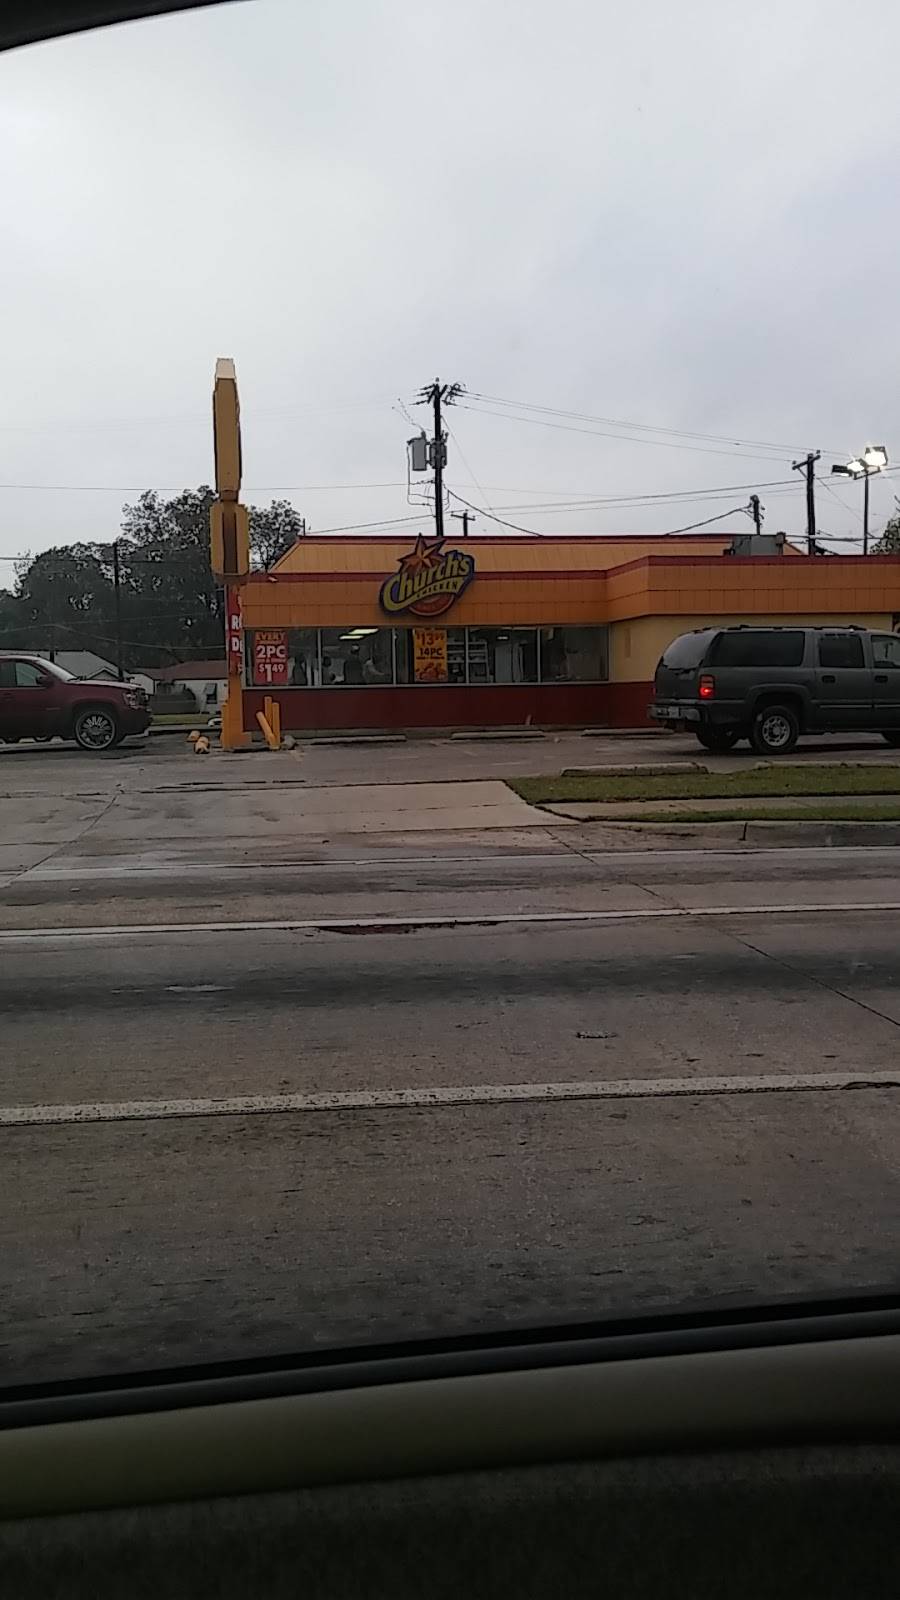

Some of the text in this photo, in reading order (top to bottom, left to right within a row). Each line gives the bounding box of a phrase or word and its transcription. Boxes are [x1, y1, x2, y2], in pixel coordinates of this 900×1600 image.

[382, 553, 470, 611] Church's
[256, 645, 286, 659] 2PC
[419, 647, 443, 656] 14PC
